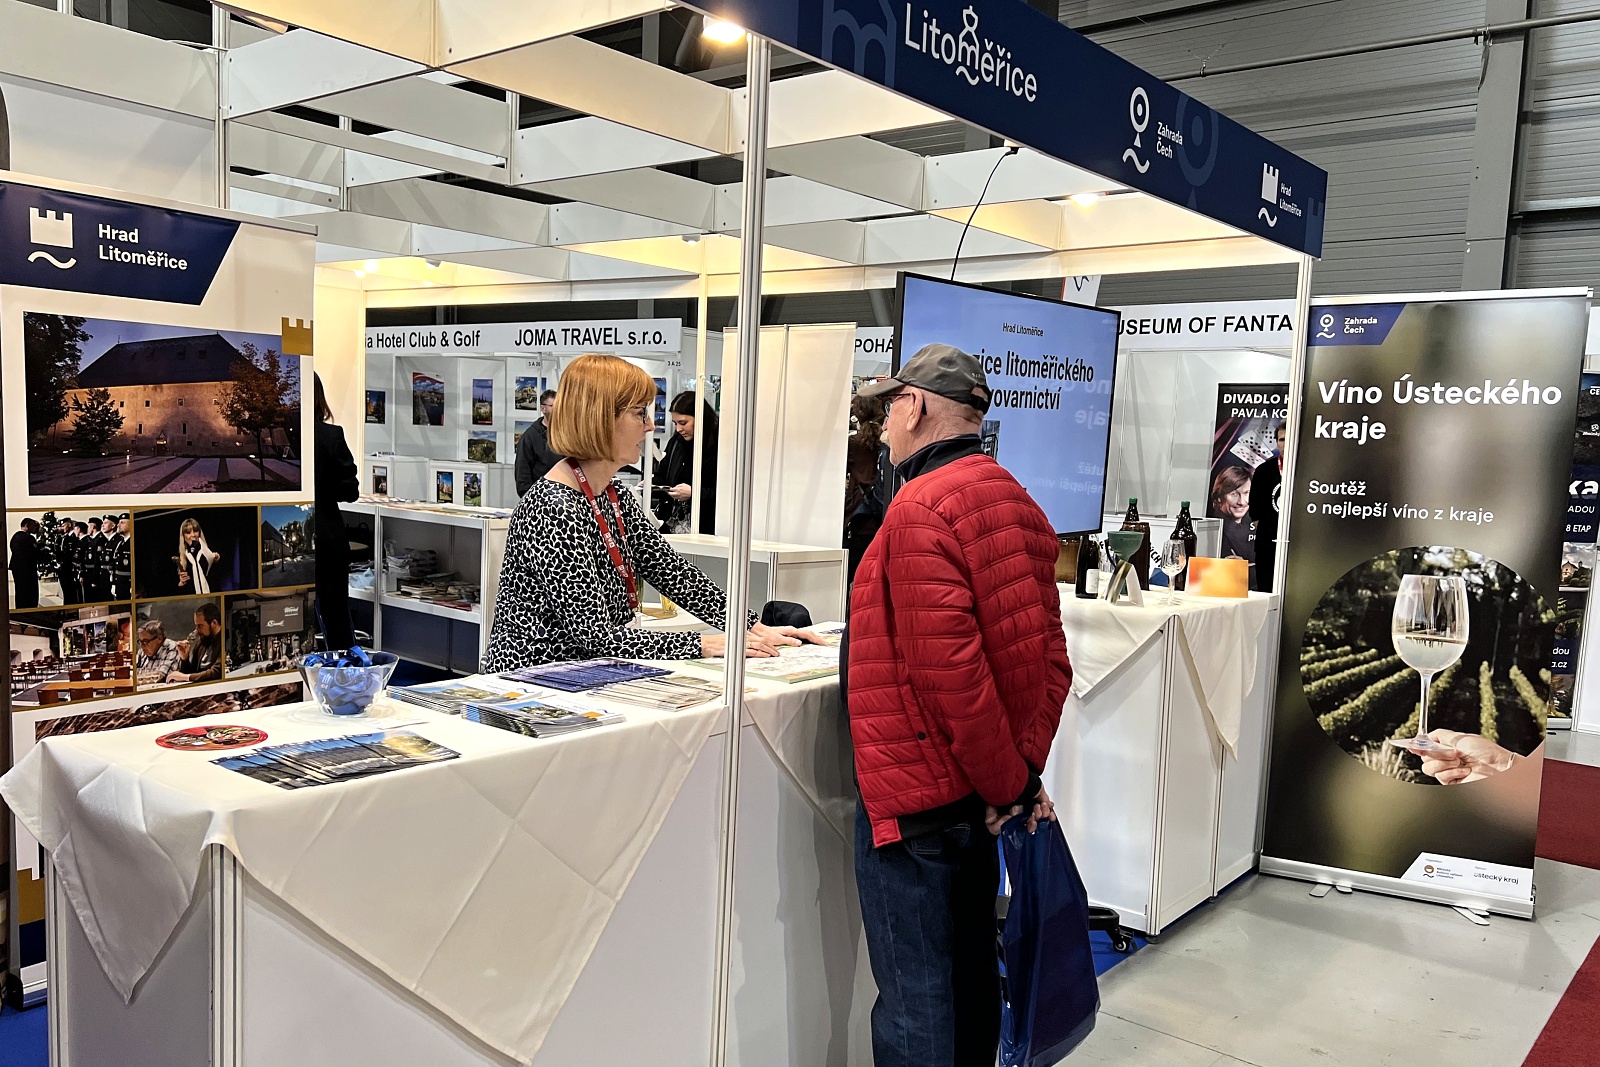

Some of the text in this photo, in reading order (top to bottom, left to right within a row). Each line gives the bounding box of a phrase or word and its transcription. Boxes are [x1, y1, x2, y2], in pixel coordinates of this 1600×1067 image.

[905, 3, 1037, 102] Litoměřice
[1157, 121, 1183, 146] Zahrada
[1156, 136, 1173, 159] Čech
[98, 223, 139, 244] Hrad
[98, 244, 188, 270] Litoměřice
[1002, 322, 1016, 334] Hrad
[1188, 316, 1217, 334] OF
[1223, 314, 1293, 333] FANTA
[1343, 325, 1365, 334] Čech
[1344, 316, 1378, 325] Zahrada
[376, 332, 406, 348] Hotel
[409, 331, 437, 348] Club
[440, 330, 450, 347] &
[453, 330, 481, 347] Golf
[514, 327, 667, 346] JOMA TRAVEL s.r.o.
[1005, 350, 1094, 382] litoměřického
[1223, 393, 1281, 405] DIVADLO
[1318, 373, 1562, 405] Víno Ústeckého
[1231, 407, 1269, 419] PAVLA
[1314, 414, 1387, 446] kraje
[1308, 480, 1367, 496] Soutěž
[1306, 501, 1494, 526] o nejlepší víno z kraje
[1573, 524, 1592, 533] ETAP
